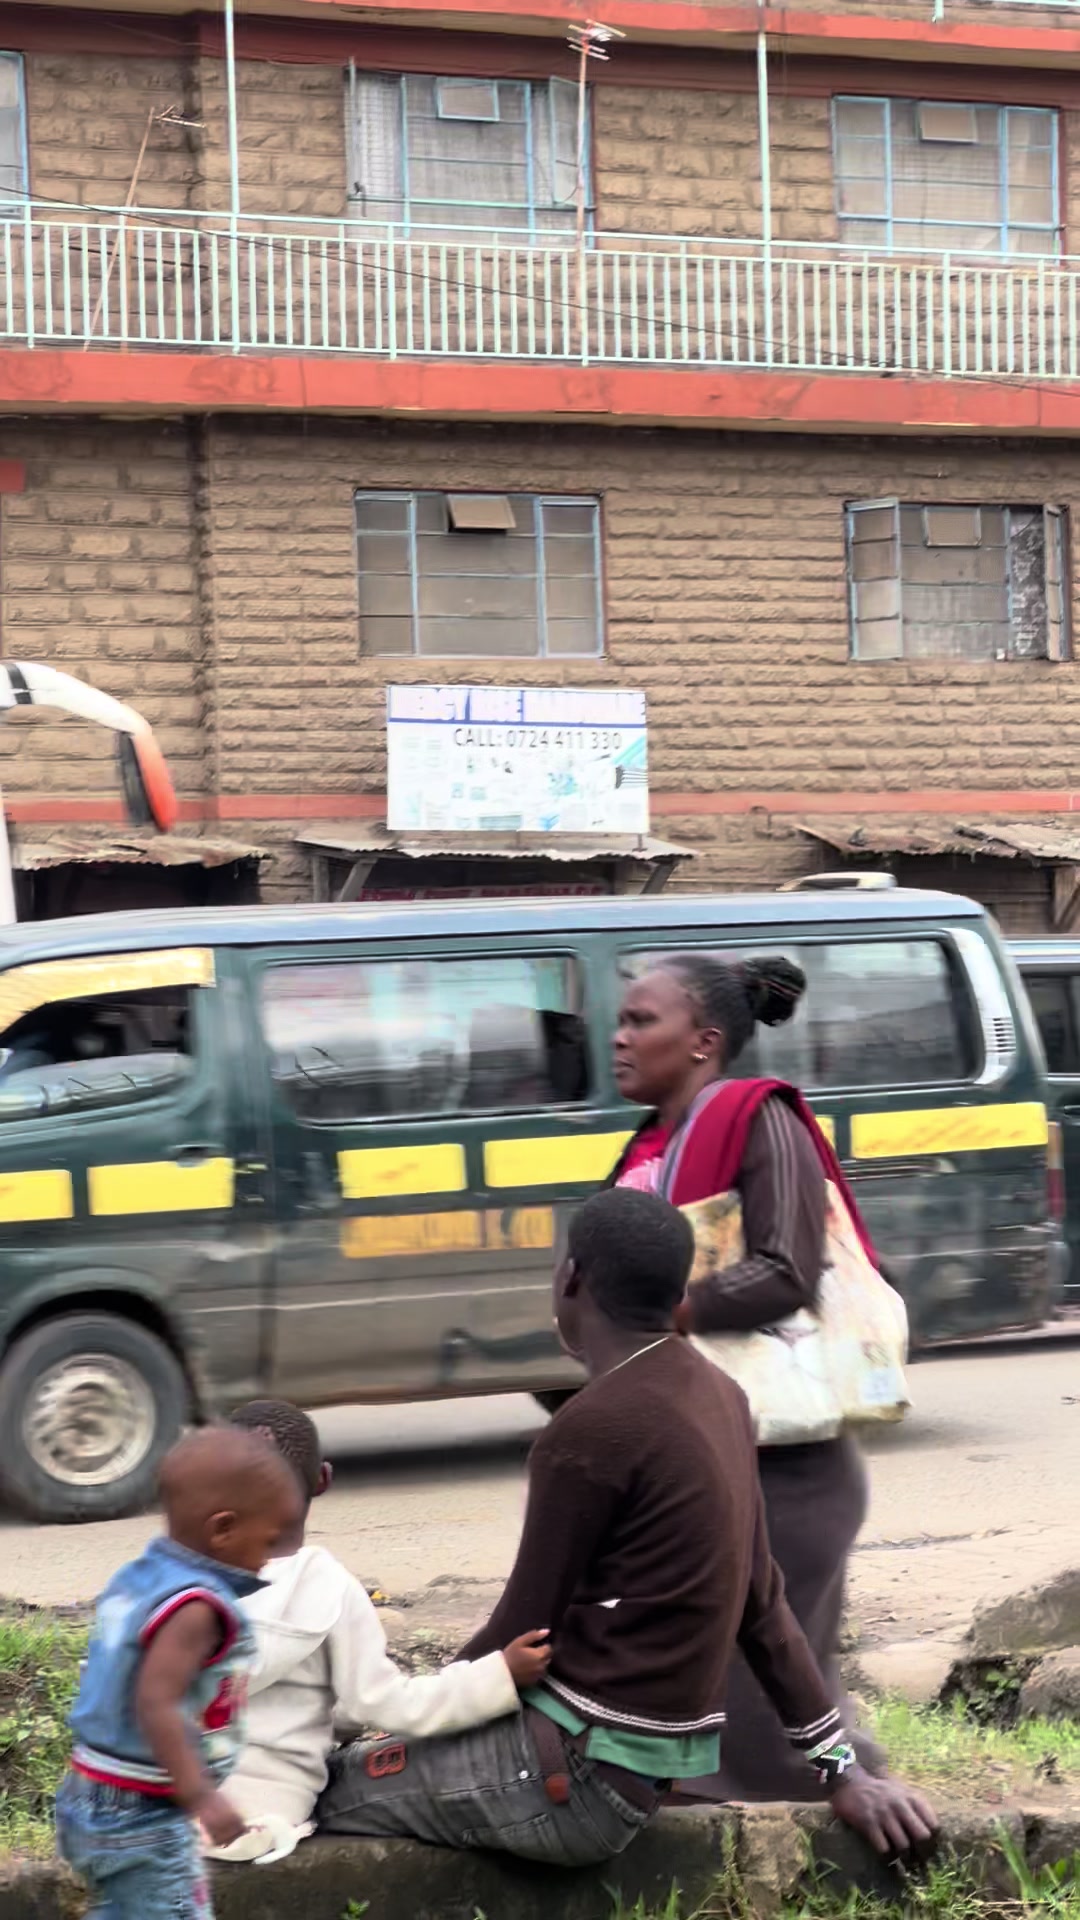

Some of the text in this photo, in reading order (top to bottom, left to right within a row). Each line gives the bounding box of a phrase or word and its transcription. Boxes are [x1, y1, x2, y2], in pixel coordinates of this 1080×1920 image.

[455, 728, 622, 750] CALL: 0724 411 330
